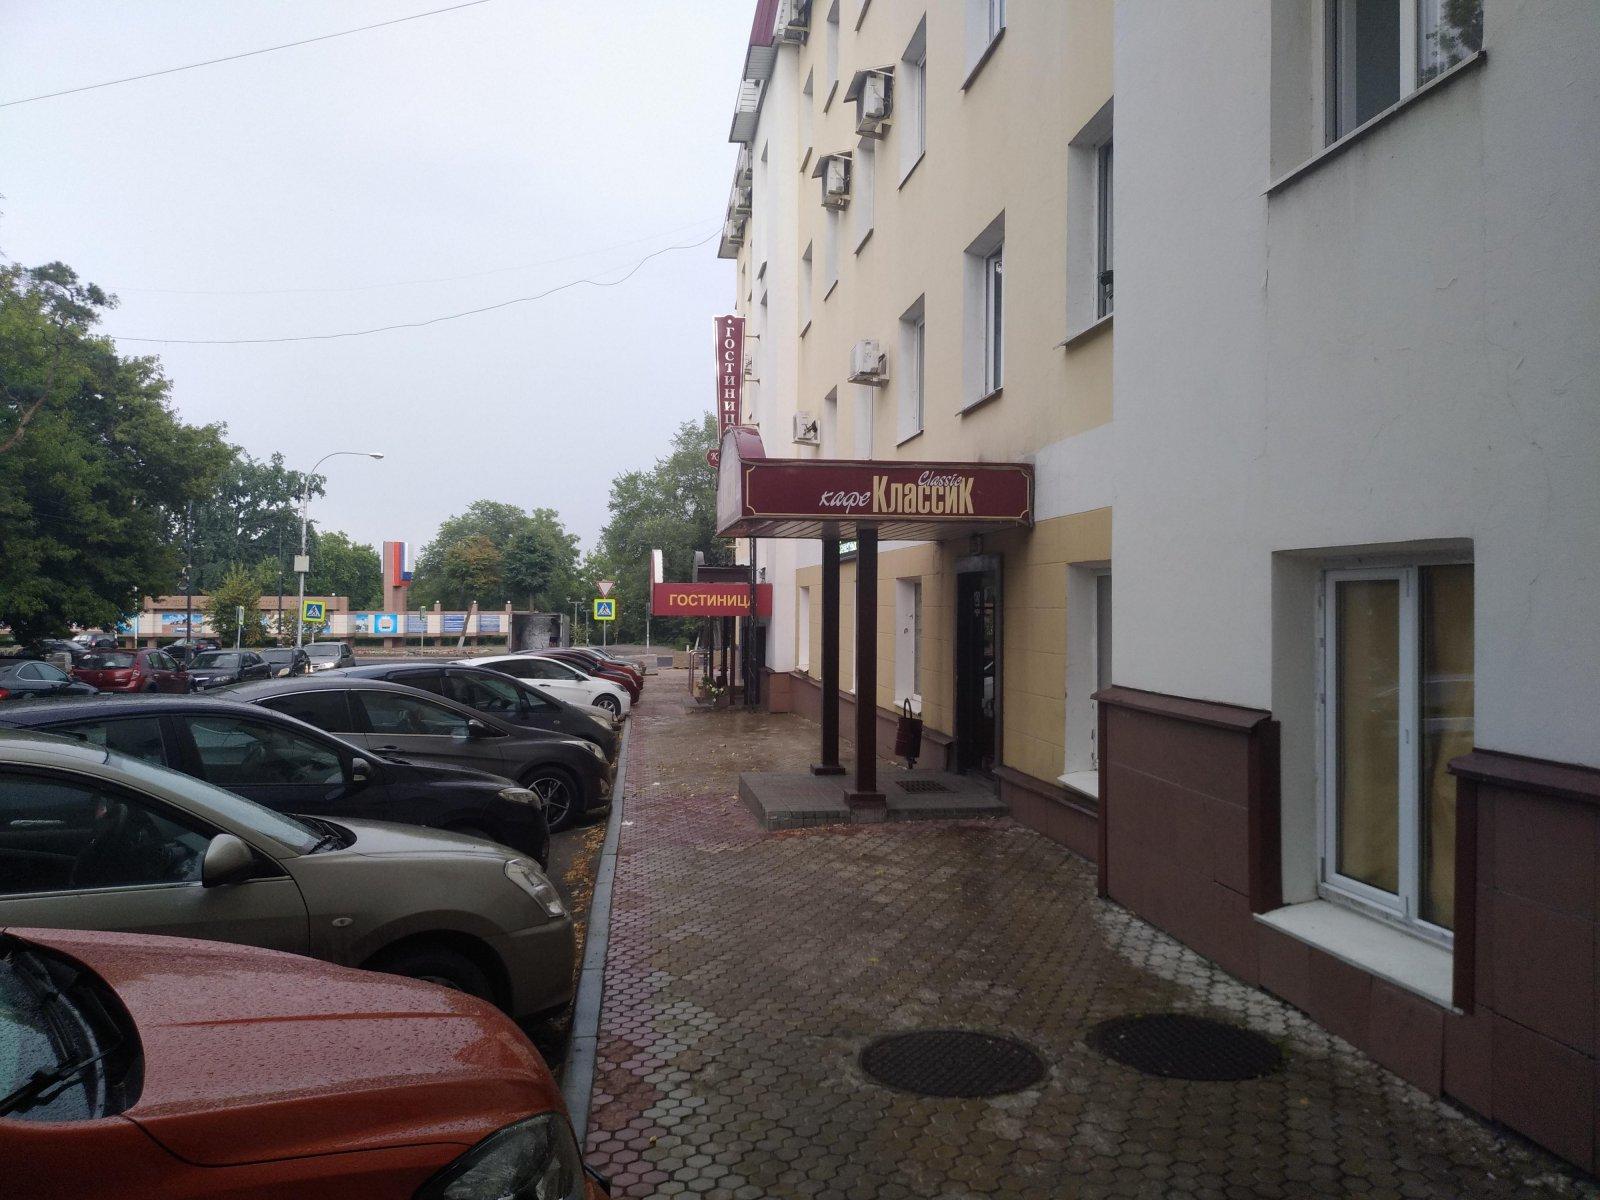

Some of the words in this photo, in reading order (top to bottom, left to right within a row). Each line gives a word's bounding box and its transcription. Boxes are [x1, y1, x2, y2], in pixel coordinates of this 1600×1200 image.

[724, 327, 736, 425] ГОСТИНИЦ
[917, 470, 964, 487] Classic
[818, 491, 871, 514] кафе
[669, 594, 757, 608] ГОСТИНИЦ
